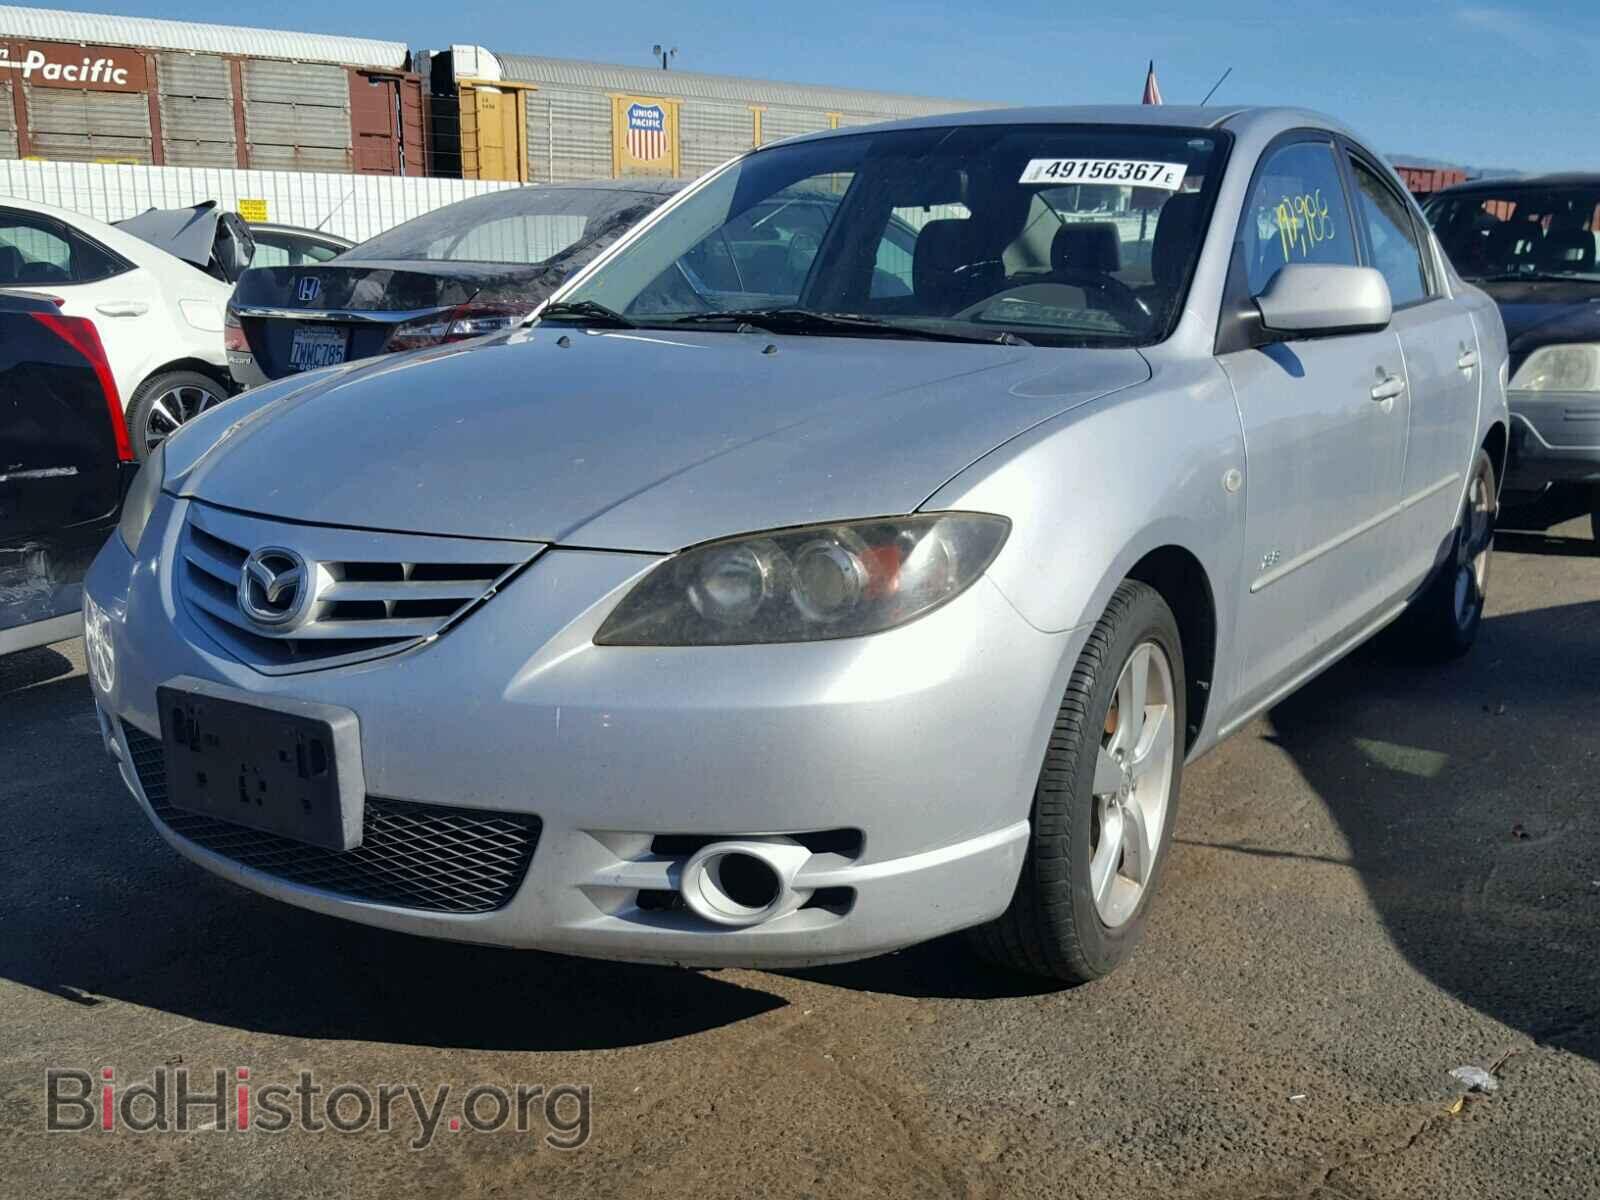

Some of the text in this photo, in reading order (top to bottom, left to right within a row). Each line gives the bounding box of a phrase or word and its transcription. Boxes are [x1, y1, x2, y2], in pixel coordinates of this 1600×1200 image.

[23, 49, 128, 85] Pacific
[632, 108, 660, 119] UNION
[631, 118, 661, 128] PACIFIC
[1044, 160, 1165, 182] 49156367
[1164, 172, 1174, 183] E
